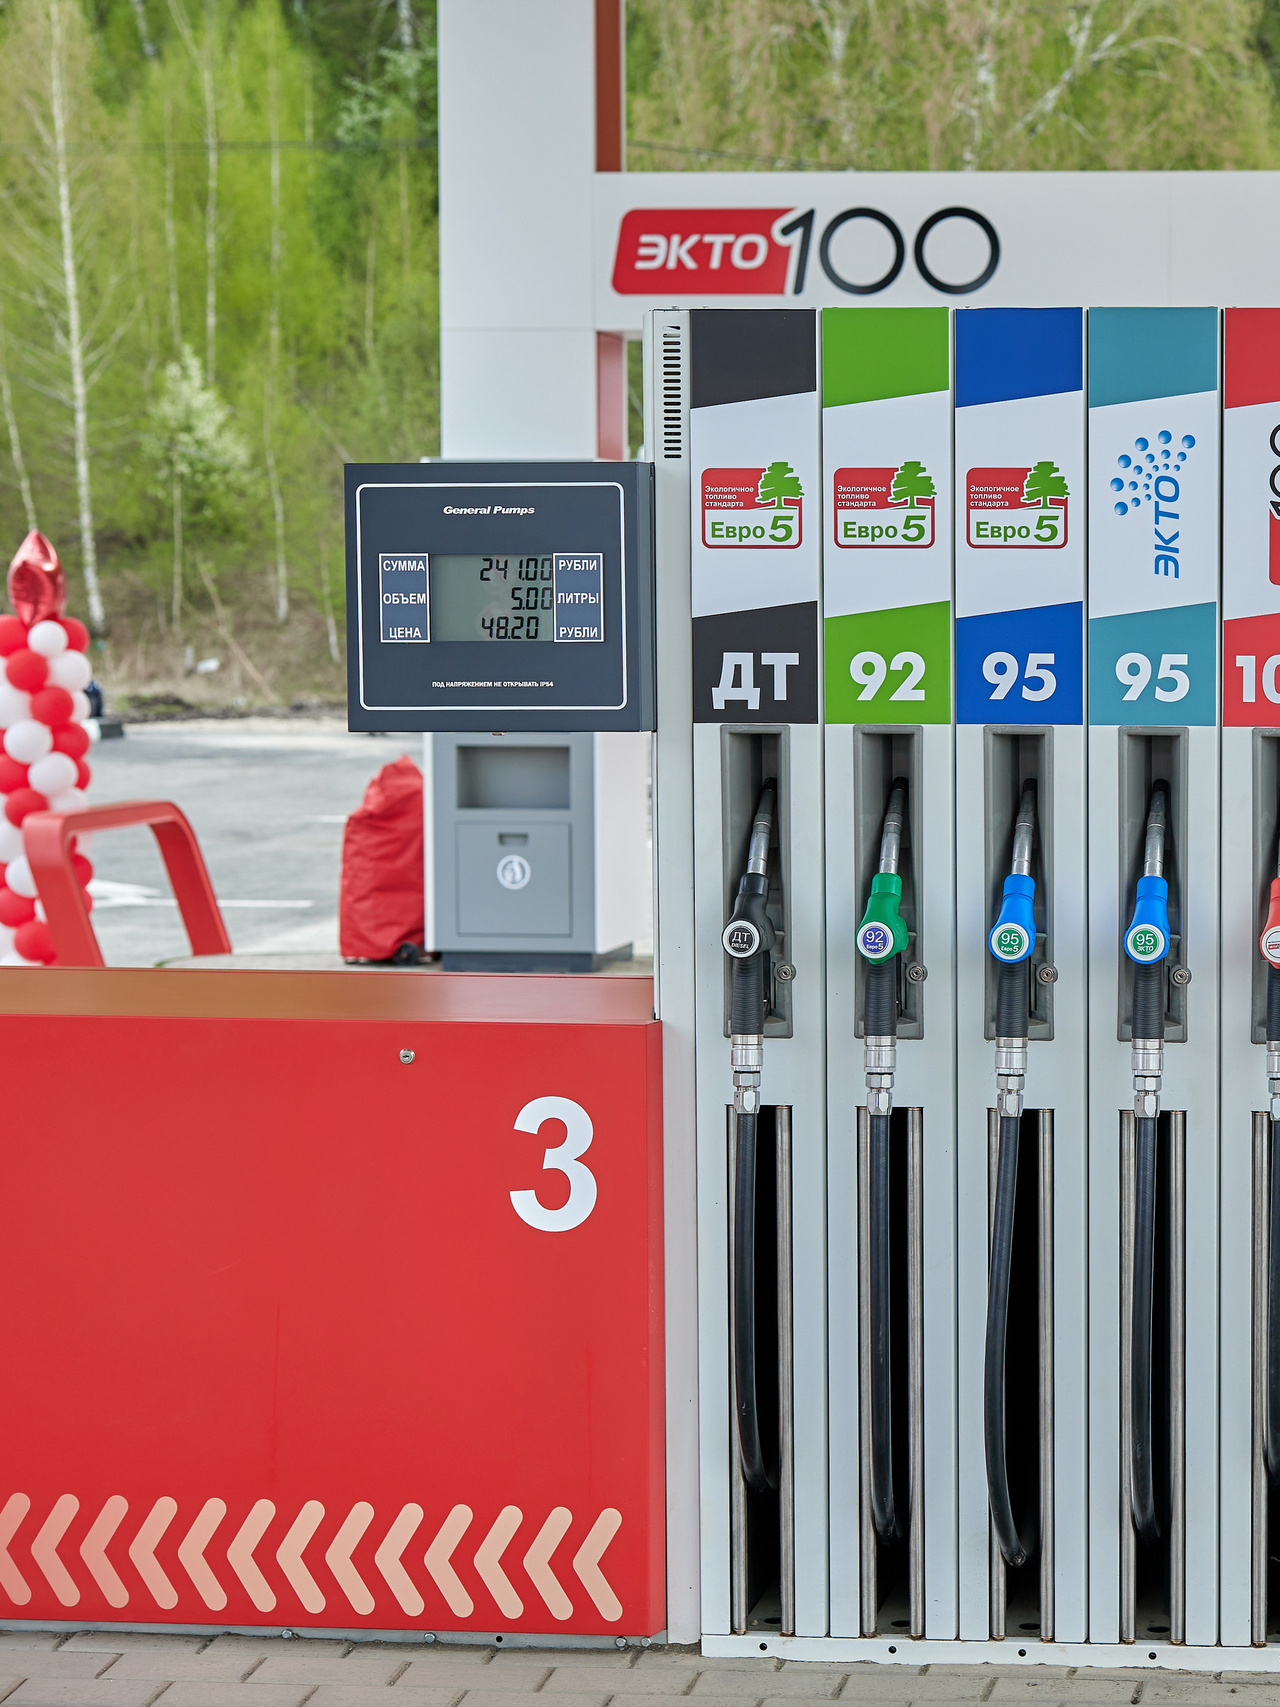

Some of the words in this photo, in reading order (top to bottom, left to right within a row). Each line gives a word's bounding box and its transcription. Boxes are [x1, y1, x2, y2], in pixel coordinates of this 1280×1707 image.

[634, 233, 769, 270] ЭКТО
[781, 206, 1000, 295] 100
[705, 485, 754, 493] Экологичное
[837, 485, 887, 493] Экологичное
[969, 485, 1020, 493] Экологичное
[443, 505, 491, 515] General
[493, 505, 535, 516] Pumps
[710, 522, 765, 542] Евро
[768, 515, 794, 542] 5
[842, 522, 898, 542] Евро
[901, 515, 927, 542] 5
[975, 522, 1031, 542] Евро
[1033, 515, 1060, 542] 5
[1154, 475, 1180, 579] ЭКТО
[383, 560, 426, 571] СУММА
[480, 558, 552, 581] 241.00
[558, 560, 597, 571] РУБЛИ
[383, 593, 426, 604] ОБЪЕМ
[511, 587, 552, 610] 5.00
[557, 592, 599, 603] ЛИТРЫ
[389, 627, 422, 640] ЦЕНА
[482, 616, 539, 639] 48.20
[559, 627, 598, 637] РУБЛИ
[711, 652, 799, 710] ДТ
[850, 651, 926, 701] 92
[982, 651, 1057, 702] 95
[1115, 652, 1190, 703] 95
[731, 931, 750, 943] ДТ
[866, 930, 884, 943] 92
[1001, 932, 1019, 945] 95
[1136, 933, 1154, 945] 95
[509, 1096, 597, 1232] 3
